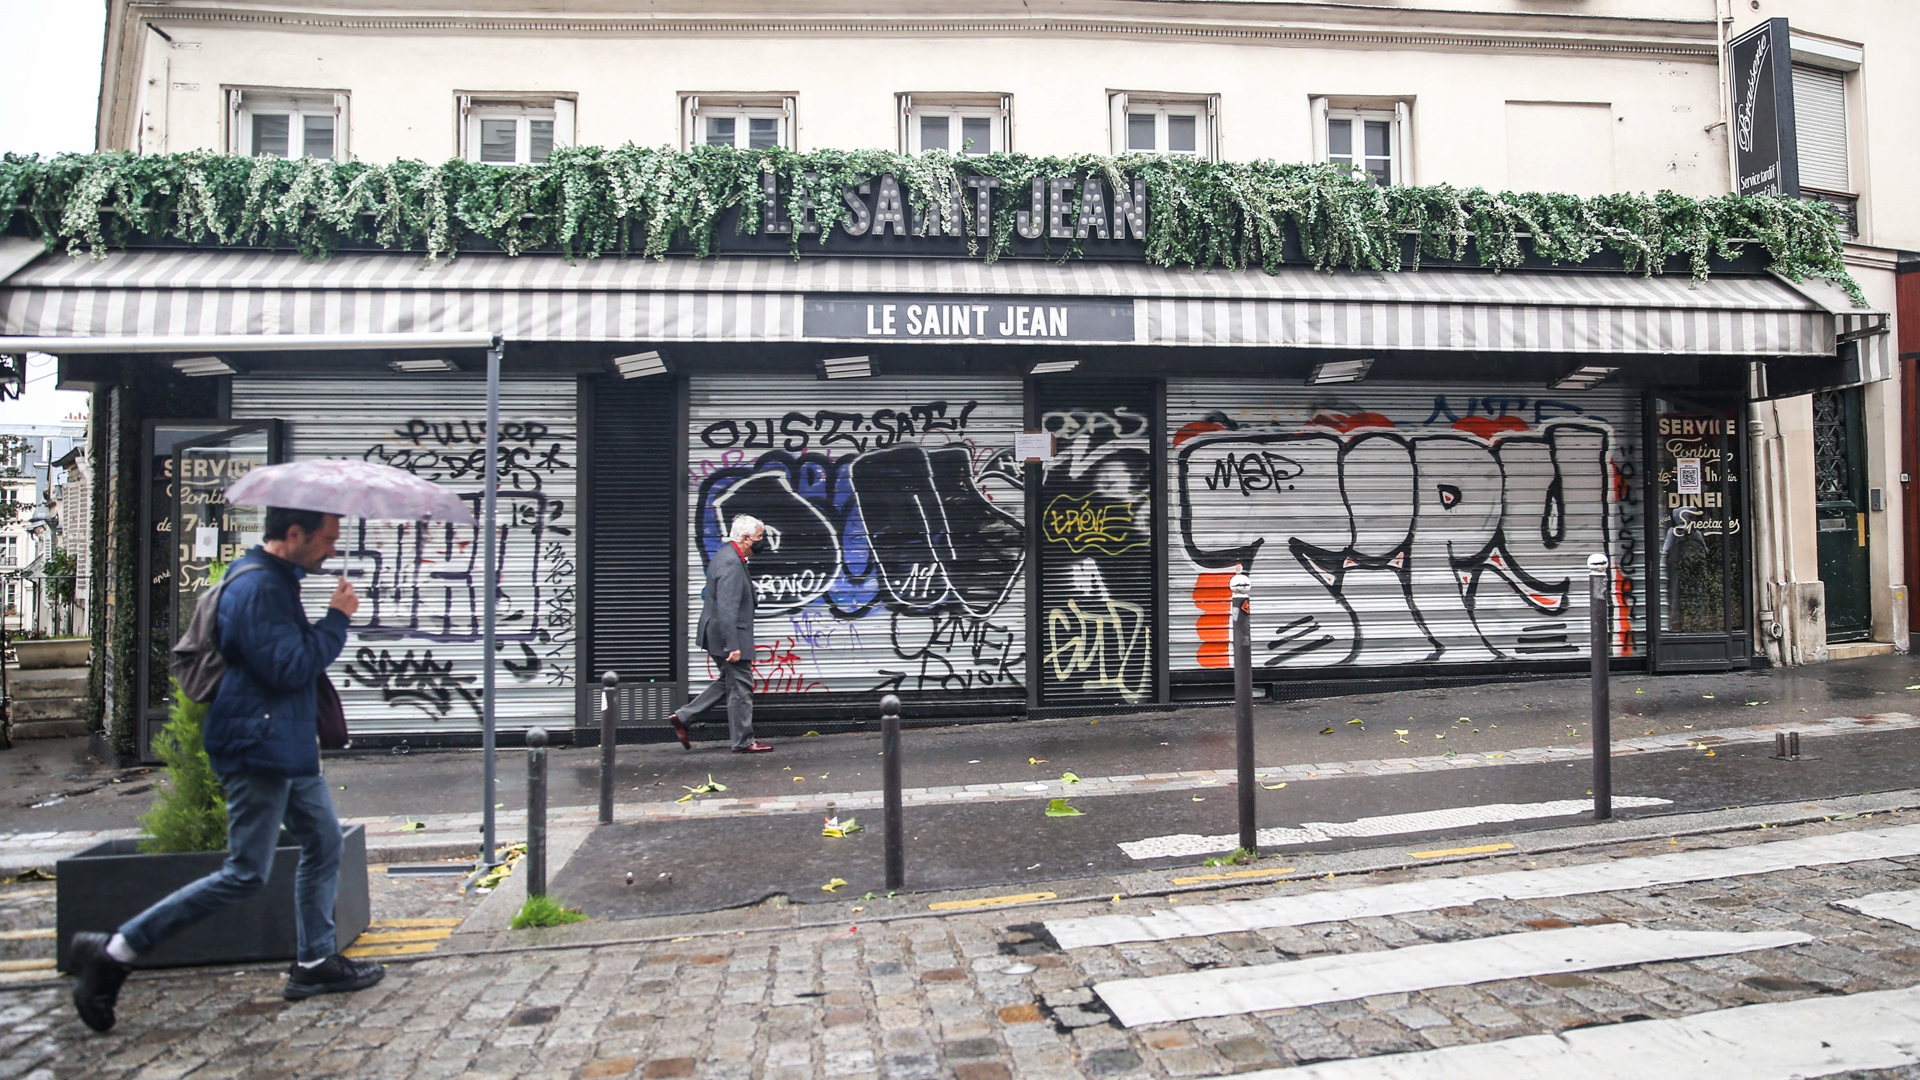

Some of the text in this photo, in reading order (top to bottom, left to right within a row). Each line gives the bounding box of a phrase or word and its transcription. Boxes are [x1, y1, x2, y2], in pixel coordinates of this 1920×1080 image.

[764, 171, 820, 235] LE
[1017, 176, 1146, 241] JEAN
[866, 304, 1069, 338] LE SAINT JEAN
[166, 479, 227, 505] Conti
[222, 513, 238, 532] 1h
[1673, 509, 1741, 537] Spectaces
[179, 543, 249, 562] DIER
